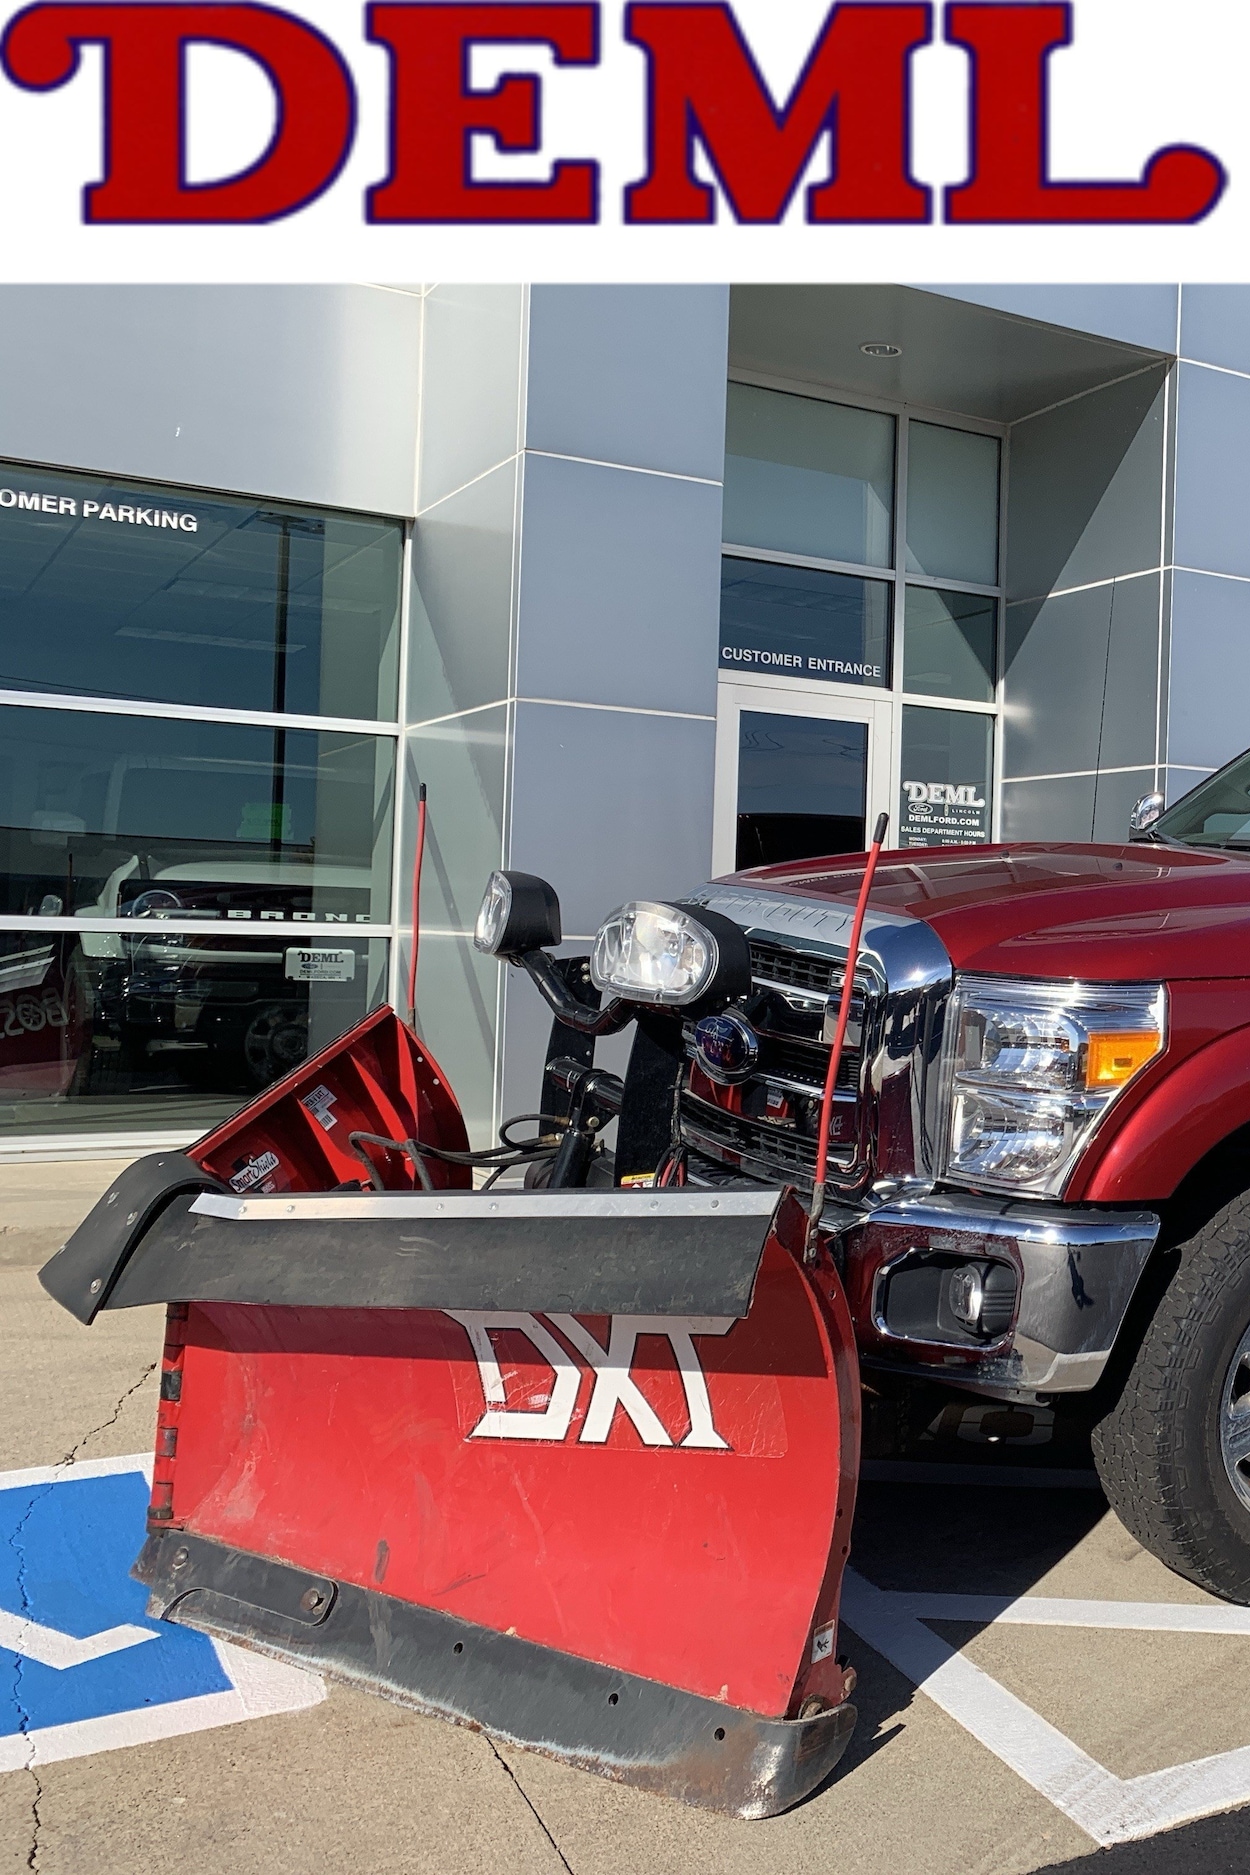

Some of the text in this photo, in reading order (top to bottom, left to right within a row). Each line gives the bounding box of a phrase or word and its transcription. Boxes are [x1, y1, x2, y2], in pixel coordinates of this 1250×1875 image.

[82, 500, 198, 532] PARKING
[721, 646, 881, 678] CUSTOMER ENTRANCE
[902, 781, 985, 807] DEML
[909, 815, 979, 826] DEMLFORD.COM
[922, 827, 963, 836] DEPARTMENT
[298, 951, 344, 963] DEML
[440, 1309, 740, 1452] DXT
